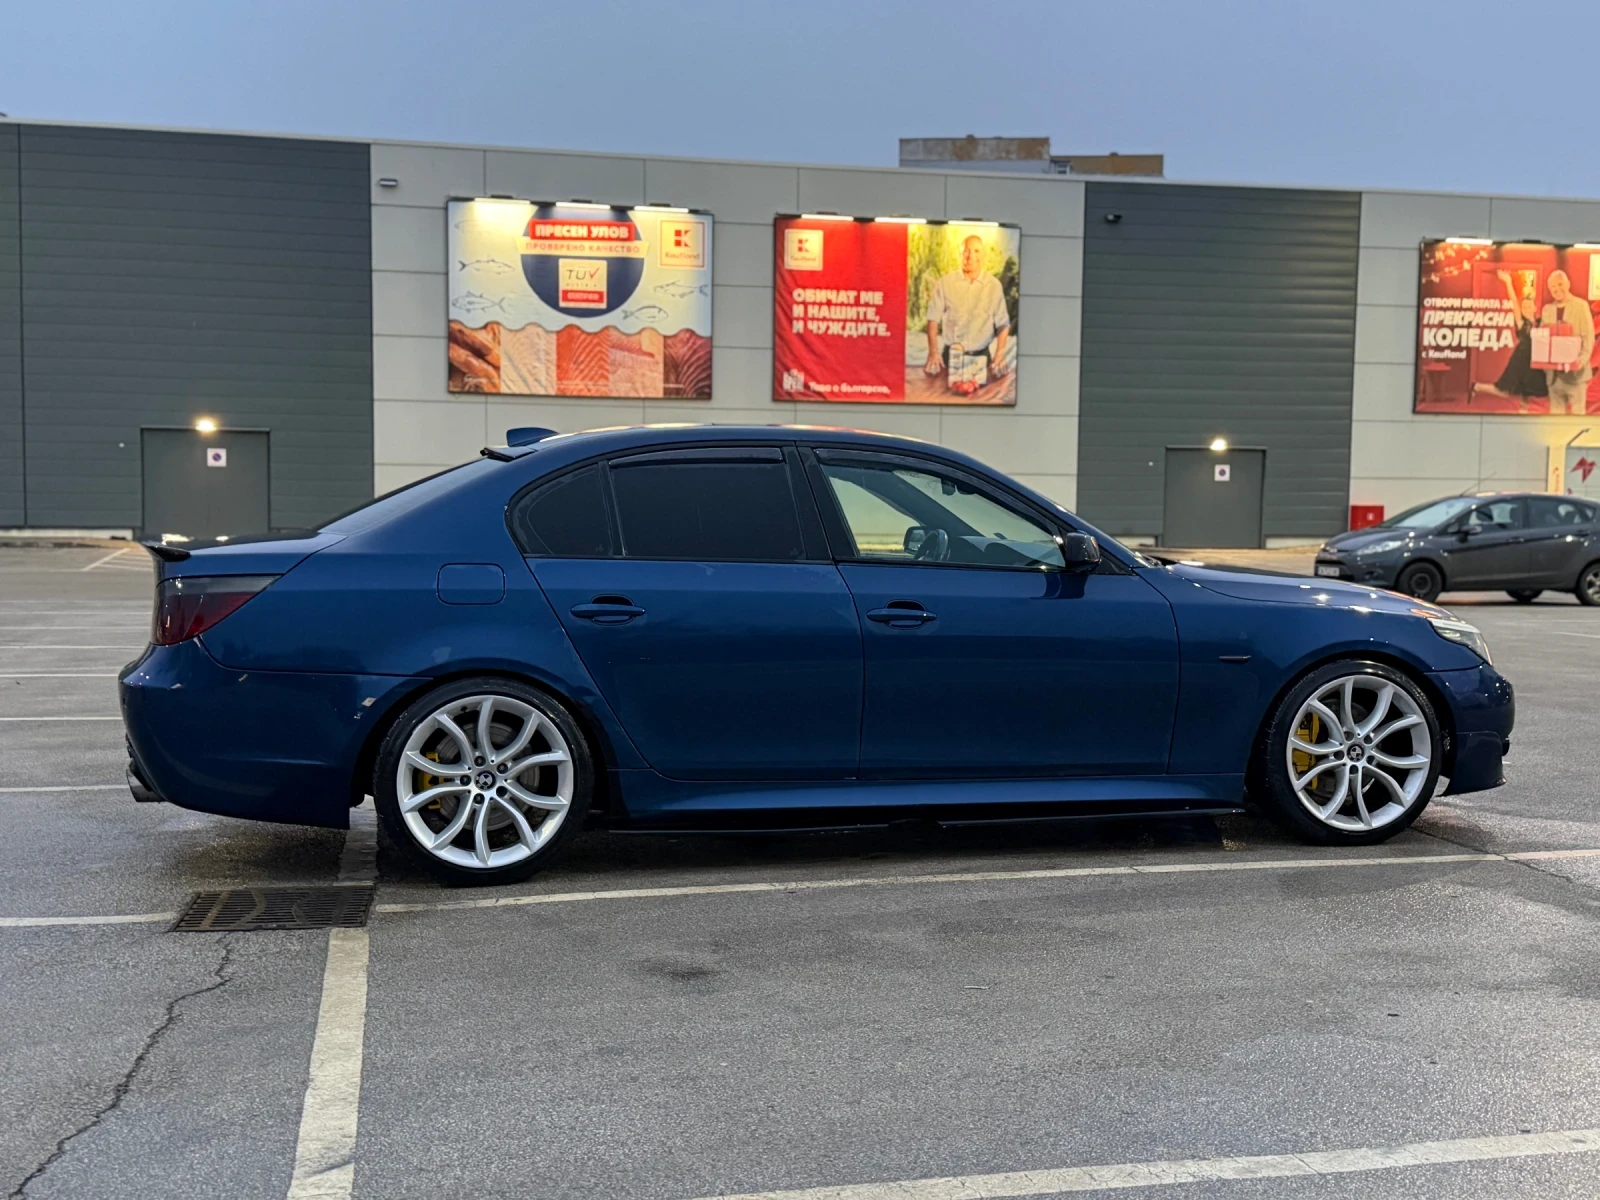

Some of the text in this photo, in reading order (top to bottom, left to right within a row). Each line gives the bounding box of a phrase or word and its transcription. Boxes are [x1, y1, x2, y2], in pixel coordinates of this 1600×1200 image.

[535, 224, 629, 239] ПРЕСЕН УЛОВ
[525, 242, 640, 254] ПРОВЕРЕНО КАЧЕСТВО
[792, 288, 884, 305] ОБИЧАТ МЕ
[1423, 297, 1461, 308] ОТВОРИ
[1462, 297, 1501, 309] ВРАТАТА
[792, 303, 880, 322] И НАШИТЕ,
[1423, 310, 1515, 327] ПРЕКРАСНА
[792, 319, 891, 338] И ЧУЖДИТЕ.
[1423, 328, 1515, 352] КОЛЕДА
[1428, 349, 1467, 359] Kaufland
